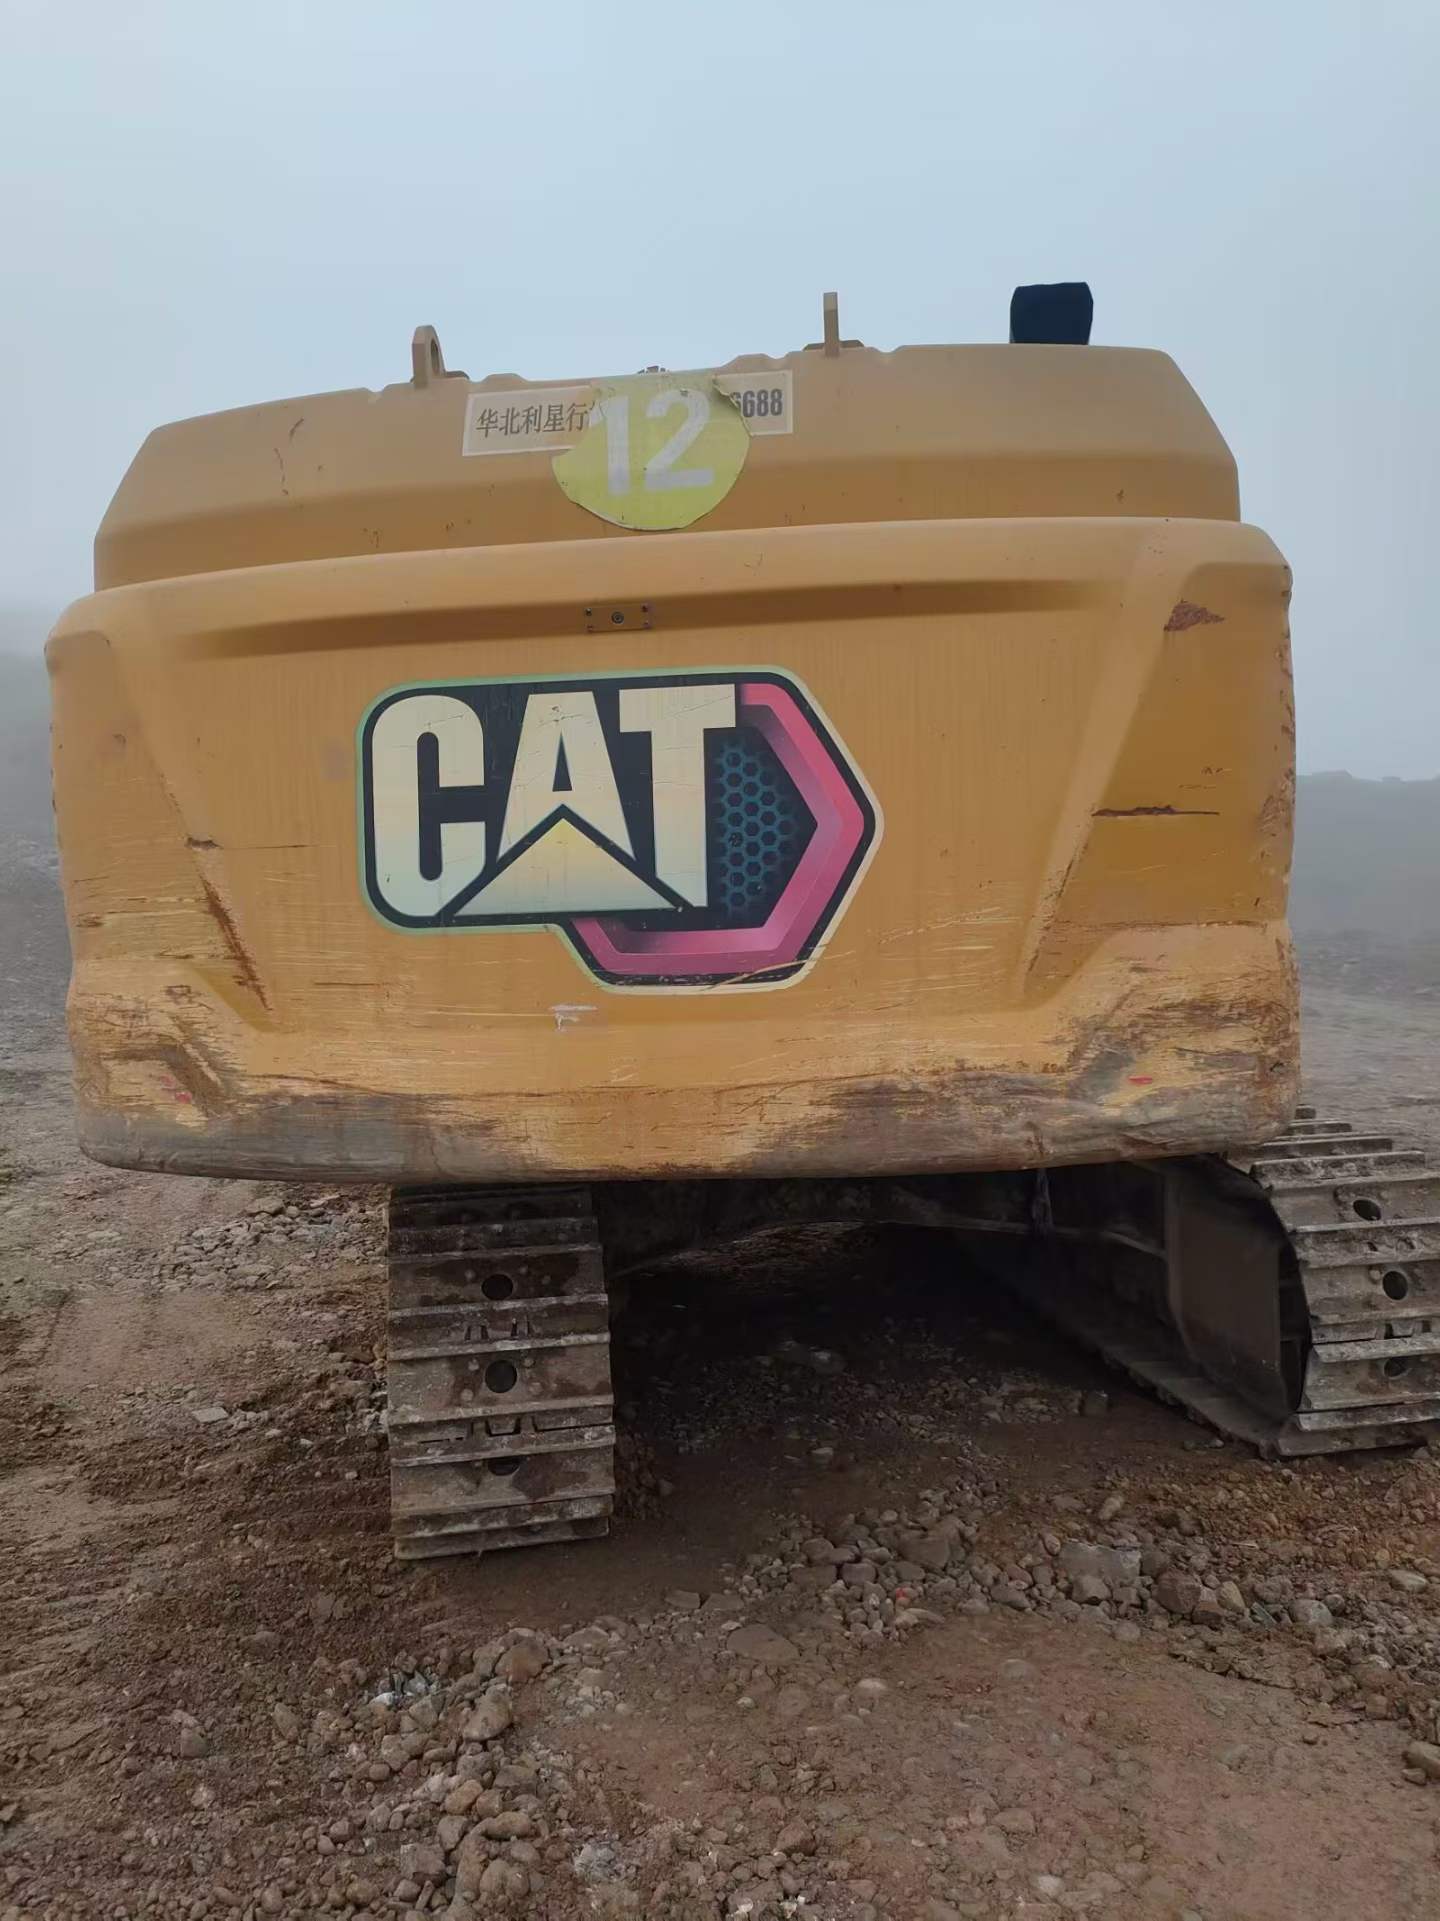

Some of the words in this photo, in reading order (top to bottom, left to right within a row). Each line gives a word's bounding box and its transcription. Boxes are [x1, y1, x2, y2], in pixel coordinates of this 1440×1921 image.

[476, 400, 596, 438] 华北利星行
[589, 387, 715, 497] 12
[372, 683, 736, 917] CAT
